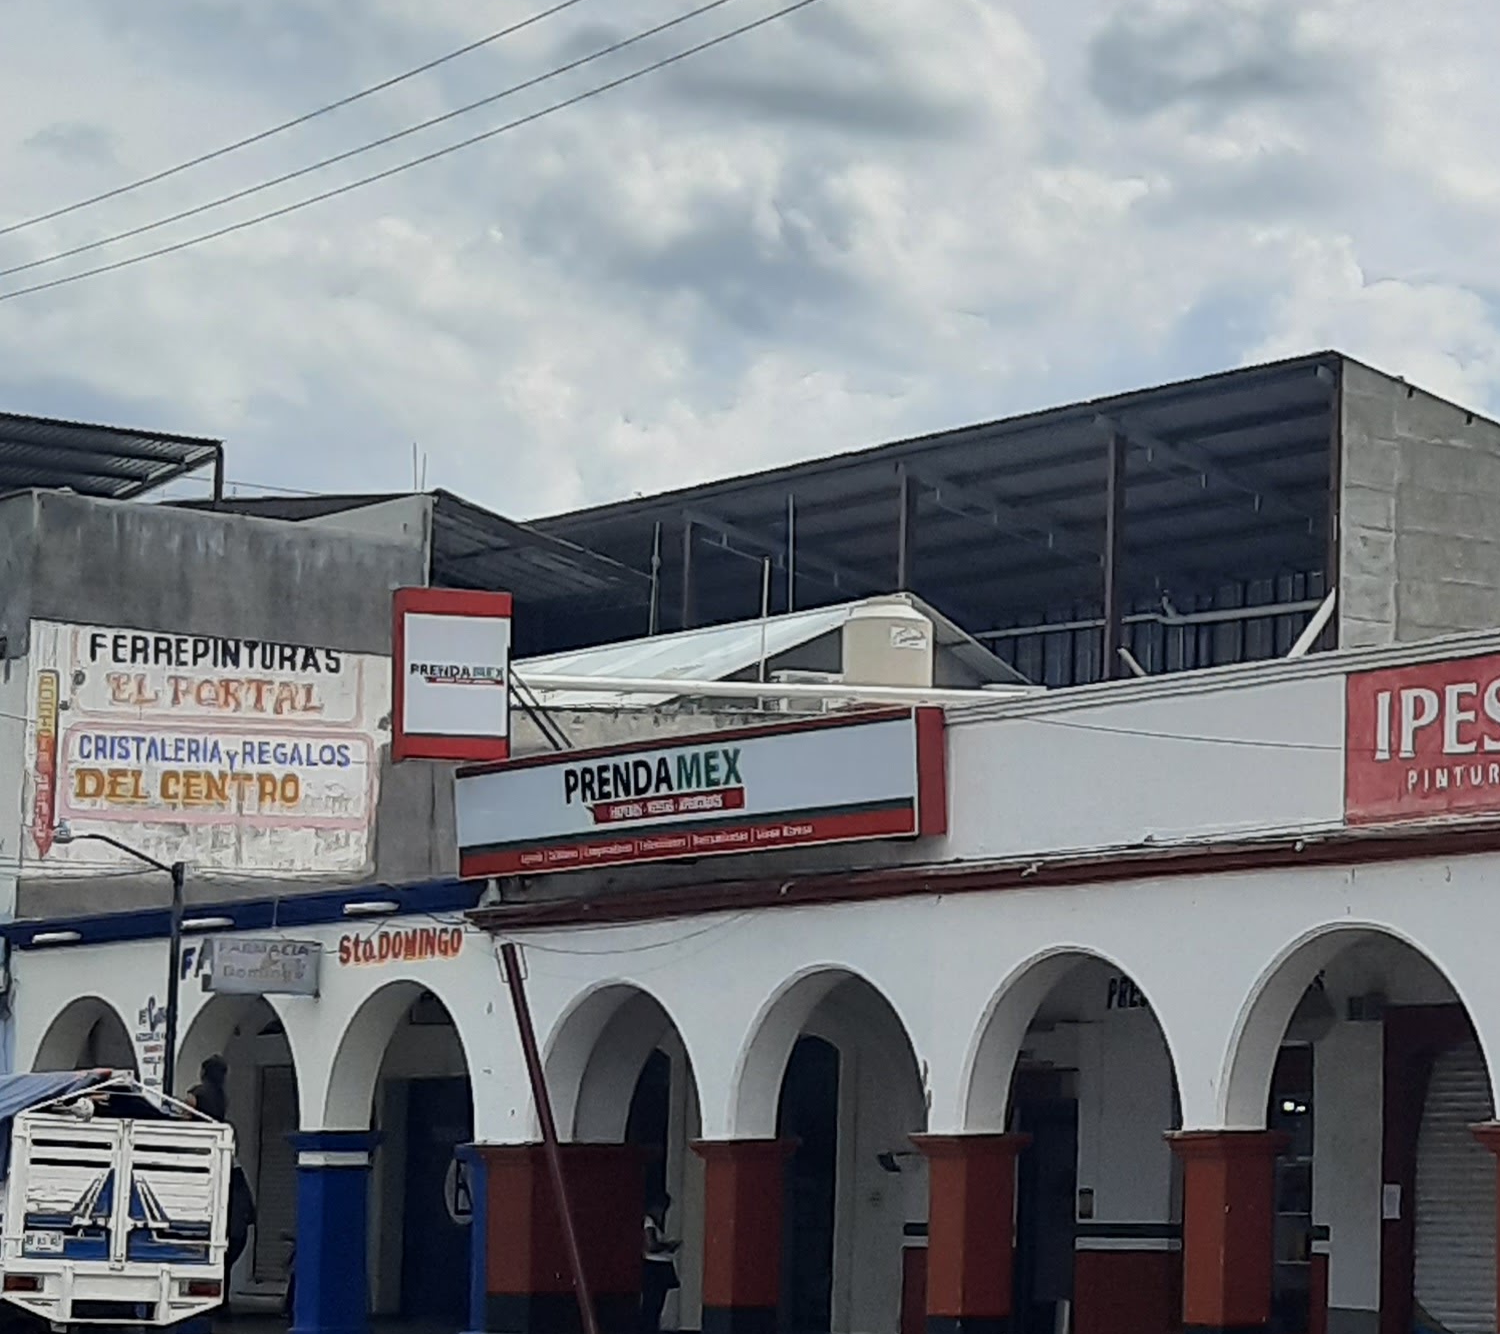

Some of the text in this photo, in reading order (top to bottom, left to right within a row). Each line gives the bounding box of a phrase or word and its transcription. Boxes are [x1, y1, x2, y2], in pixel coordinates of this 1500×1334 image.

[90, 633, 342, 674] FERREPINTURAS
[107, 672, 324, 715] EL PORTAL
[241, 741, 351, 767] REGALOS
[74, 768, 149, 801] DEL
[160, 770, 300, 806] CENTRO
[565, 748, 742, 804] PRENDAMEX
